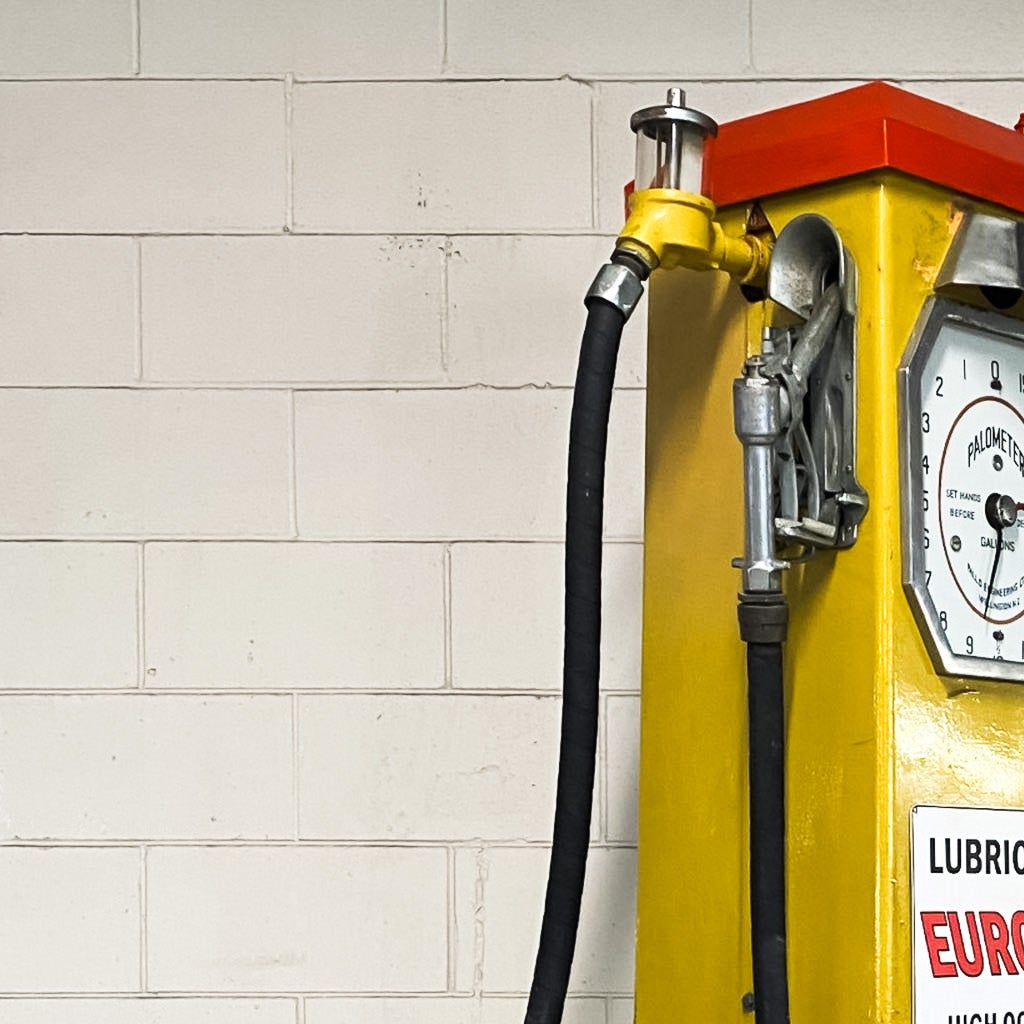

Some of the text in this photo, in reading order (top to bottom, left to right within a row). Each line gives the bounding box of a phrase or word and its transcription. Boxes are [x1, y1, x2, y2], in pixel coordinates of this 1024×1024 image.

[991, 360, 1000, 381] 0
[935, 376, 944, 397] 2
[922, 412, 930, 433] 3
[967, 426, 1024, 478] PALOMETER
[922, 455, 930, 475] 4
[945, 489, 981, 503] SET HANDS
[949, 507, 976, 520] BEFORE
[925, 571, 932, 587] 7
[940, 610, 948, 632] 8
[965, 635, 974, 655] 9
